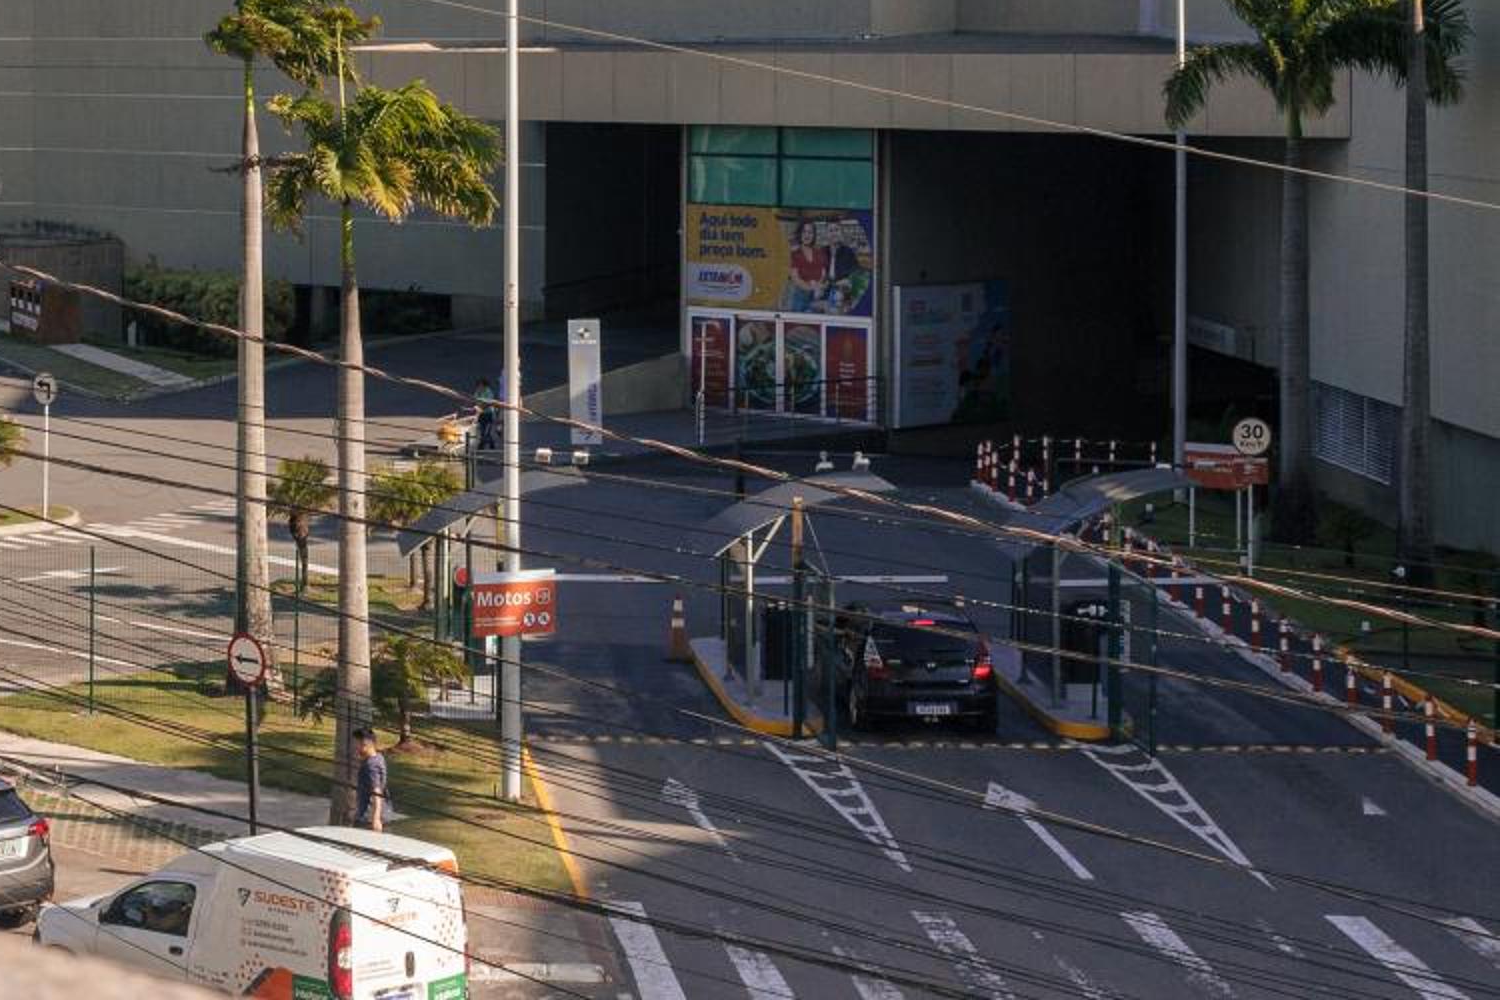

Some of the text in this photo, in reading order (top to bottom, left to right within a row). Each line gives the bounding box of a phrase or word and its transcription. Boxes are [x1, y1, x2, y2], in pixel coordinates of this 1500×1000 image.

[700, 212, 757, 229] Aqui todo
[700, 229, 745, 243] dia tem
[1241, 423, 1264, 439] 30
[476, 591, 533, 607] Motos
[254, 891, 315, 912] SUDESTE
